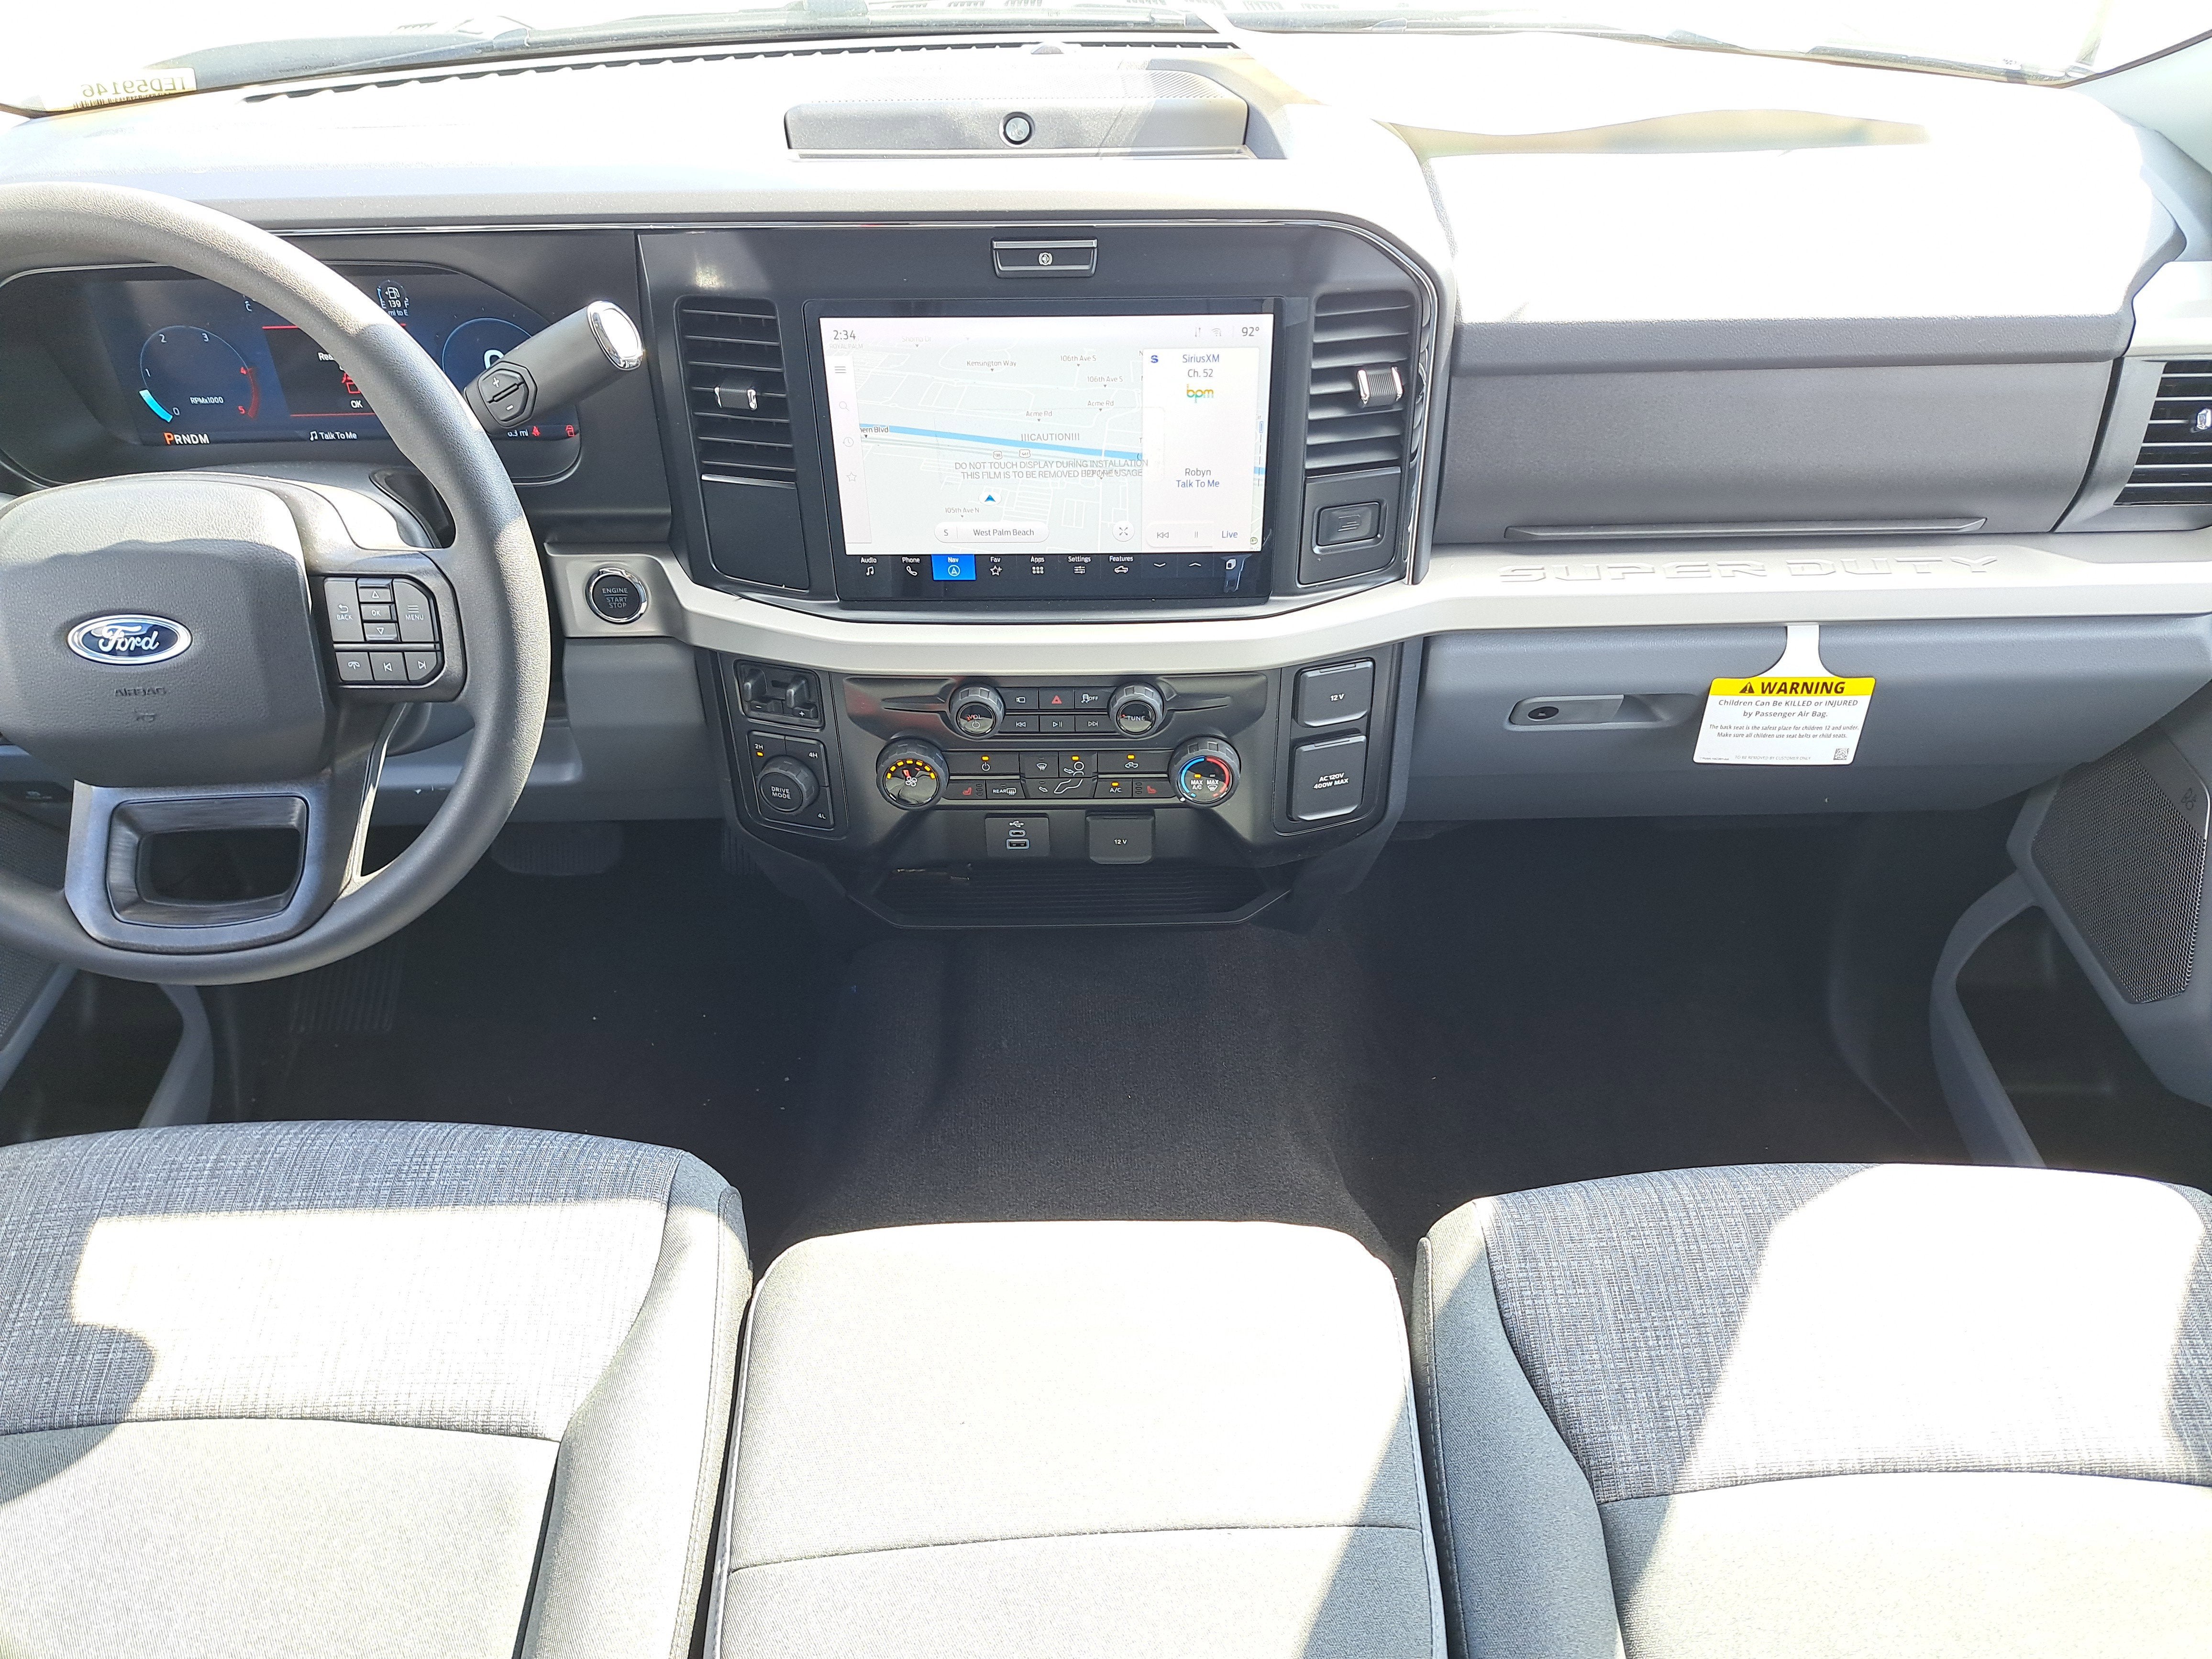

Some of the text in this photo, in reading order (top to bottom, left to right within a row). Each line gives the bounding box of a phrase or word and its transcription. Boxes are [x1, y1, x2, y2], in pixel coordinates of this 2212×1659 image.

[388, 299, 401, 308] 139
[832, 330, 856, 341] 2:34
[1241, 326, 1260, 337] 92°
[159, 333, 167, 343] 2
[201, 332, 210, 343] 3
[1182, 354, 1220, 363] SiriusXM
[967, 360, 1017, 368] Kensington Way
[145, 368, 151, 378] 1
[1187, 368, 1214, 378] Ch. 52
[1186, 384, 1214, 404] bpm
[190, 396, 224, 405] RPMx1000
[350, 400, 364, 409] OK
[172, 407, 181, 416] 0
[238, 406, 245, 415] 5
[320, 431, 358, 441] Talk To Me
[955, 459, 1149, 470] DO NOT TOUCH DISPLAY DURING INSTALLATION
[961, 471, 980, 479] THIS
[1038, 470, 1079, 478] REMOVED
[1115, 469, 1143, 477] USAGE
[1184, 468, 1212, 478] Robyn
[1176, 479, 1220, 488] Talk To Me
[1221, 530, 1238, 539] Live
[1030, 555, 1045, 564] Apps
[1068, 555, 1092, 563] Settings
[1497, 556, 1998, 583] SUPER DUTY
[91, 624, 160, 652] Ford
[1760, 681, 1847, 695] WARNING
[1825, 699, 1858, 708] INJURED
[1743, 710, 1753, 719] by
[1755, 710, 1796, 719] Passenger
[1811, 711, 1828, 719] Bag.
[808, 751, 818, 759] 4H
[1328, 772, 1345, 781] 120V
[1313, 777, 1349, 789] 400W MAX
[771, 785, 791, 794] DRIVE
[771, 791, 792, 800] MODE
